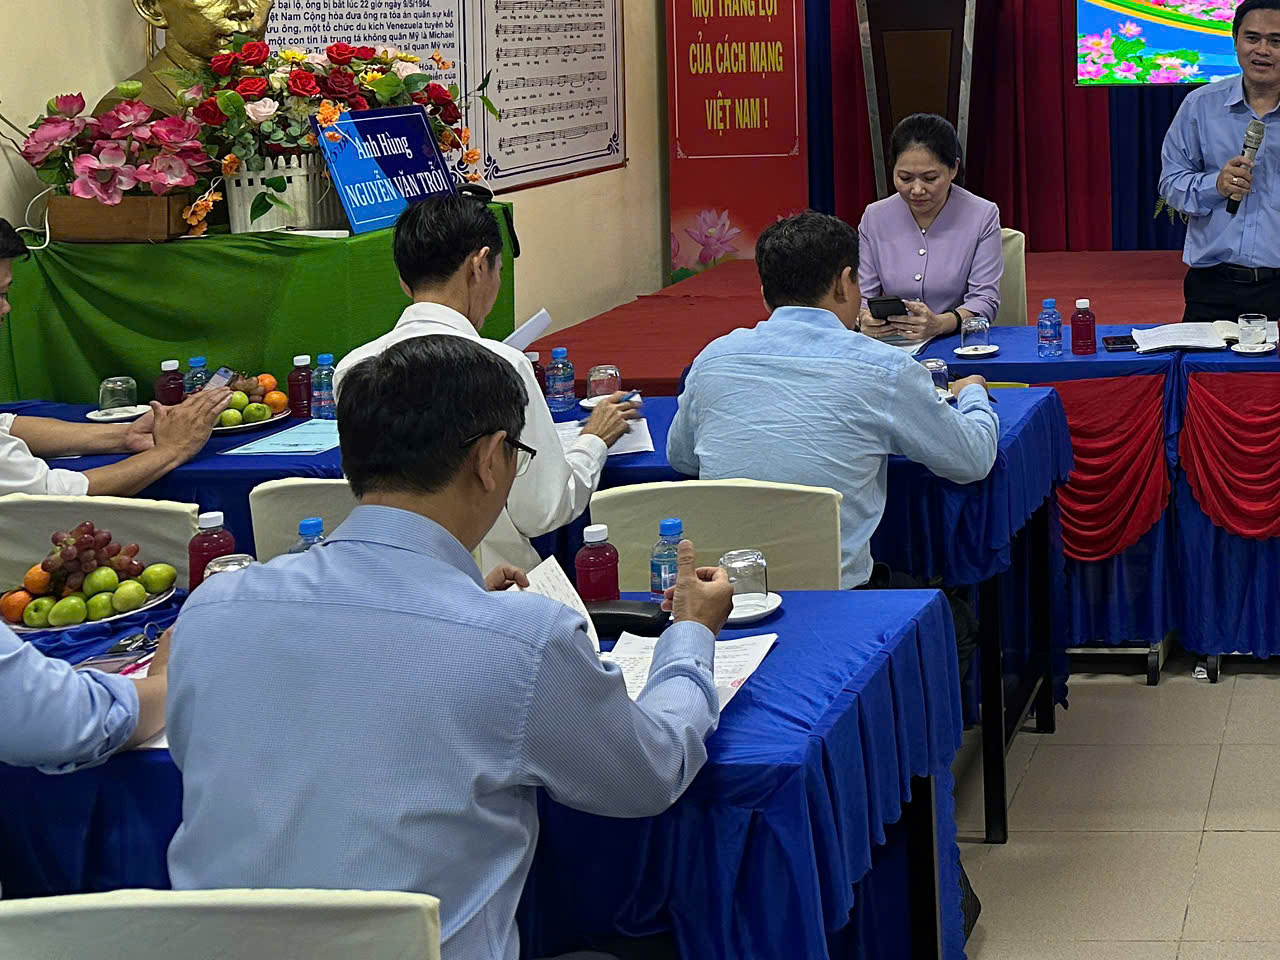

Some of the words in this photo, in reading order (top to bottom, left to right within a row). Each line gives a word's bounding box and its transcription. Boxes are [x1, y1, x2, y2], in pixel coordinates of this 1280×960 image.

[688, 30, 713, 74] CỦA
[715, 31, 746, 74] CÁCH
[749, 40, 784, 79] MẠNG
[705, 90, 731, 137] VIỆT
[734, 97, 761, 130] NAM
[354, 135, 381, 160] Anh
[380, 132, 414, 159] Hùng
[345, 170, 398, 208] NGUYỄN
[393, 170, 422, 198] VĂN
[417, 161, 449, 194] TRỖI
